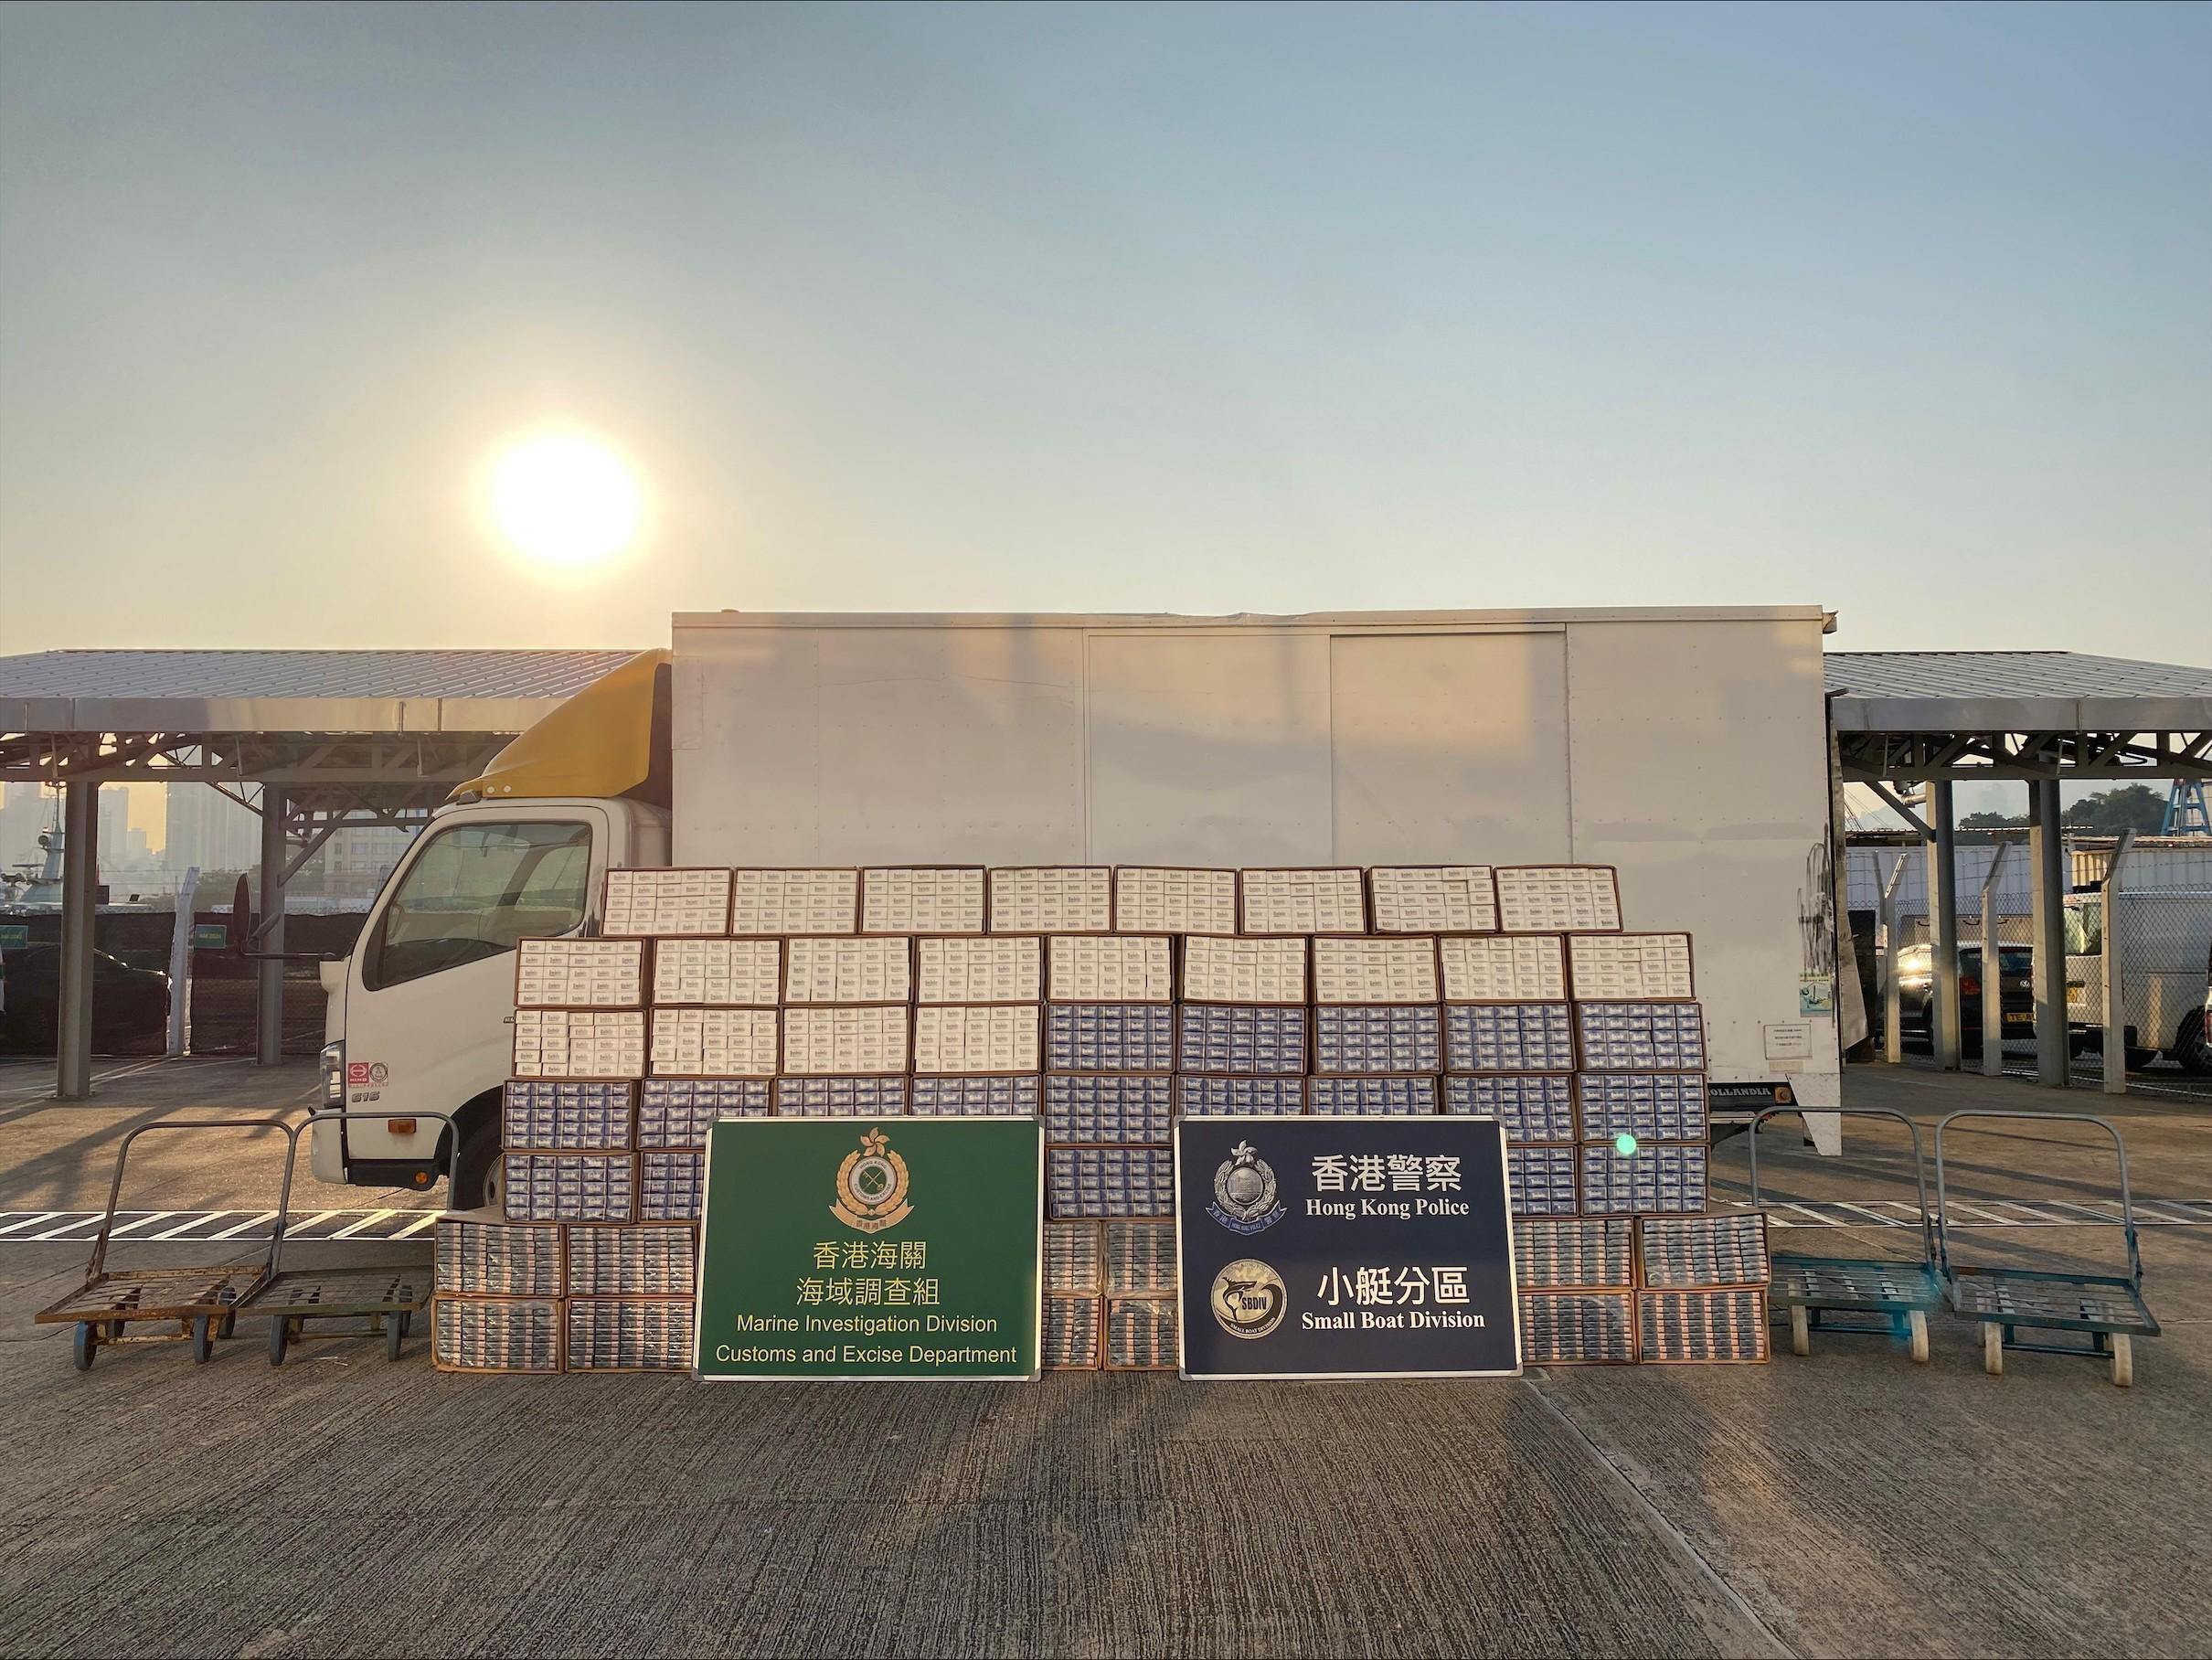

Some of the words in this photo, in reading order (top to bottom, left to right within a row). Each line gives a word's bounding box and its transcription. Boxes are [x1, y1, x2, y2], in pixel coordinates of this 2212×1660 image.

[351, 1091, 380, 1103] 616
[1312, 1154, 1462, 1192] 香港警察
[1305, 1198, 1356, 1220] Hong
[1360, 1198, 1411, 1220] Kong
[1415, 1197, 1470, 1217] Police
[813, 1240, 927, 1270] 香港海關
[796, 1276, 941, 1306] 海域調查組
[1316, 1266, 1471, 1306] 小艇分區
[1241, 1296, 1268, 1311] SBDIV
[737, 1314, 799, 1332] Marine
[805, 1314, 920, 1336] Investigation
[926, 1314, 997, 1333] Division
[1302, 1311, 1356, 1330] Small
[1359, 1311, 1405, 1329] Boat
[1408, 1310, 1485, 1329] Division
[716, 1344, 796, 1363] Customs
[802, 1345, 836, 1363] and
[843, 1345, 903, 1363] Excise
[909, 1345, 1017, 1367] Department
